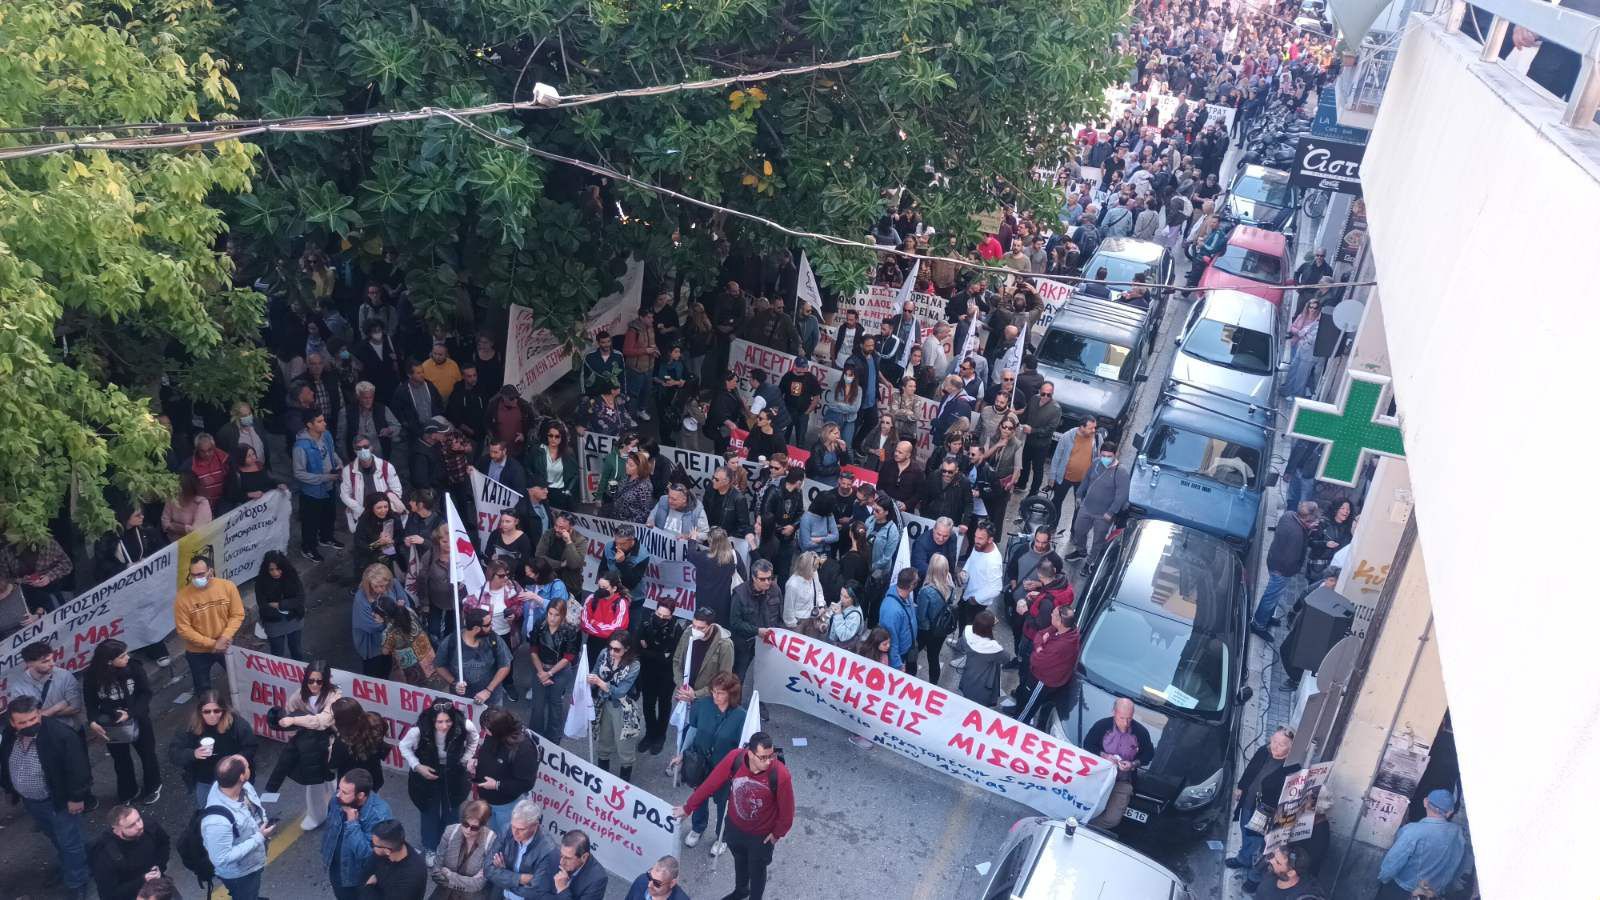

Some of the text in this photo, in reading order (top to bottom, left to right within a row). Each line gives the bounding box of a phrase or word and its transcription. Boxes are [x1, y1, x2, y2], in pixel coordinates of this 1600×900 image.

[12, 620, 44, 649] ΔΕΝ
[74, 617, 125, 654] ΜΑΣ
[352, 678, 389, 706] ΔΕΝ
[763, 629, 1099, 777] ΔΙΕΚΔΙΚΟΥΜΕ ΑΜΕΣΕΣ
[799, 670, 1074, 785] ΑΥΞΗΣΕΙΣ ΜΙΣΘΩΝ
